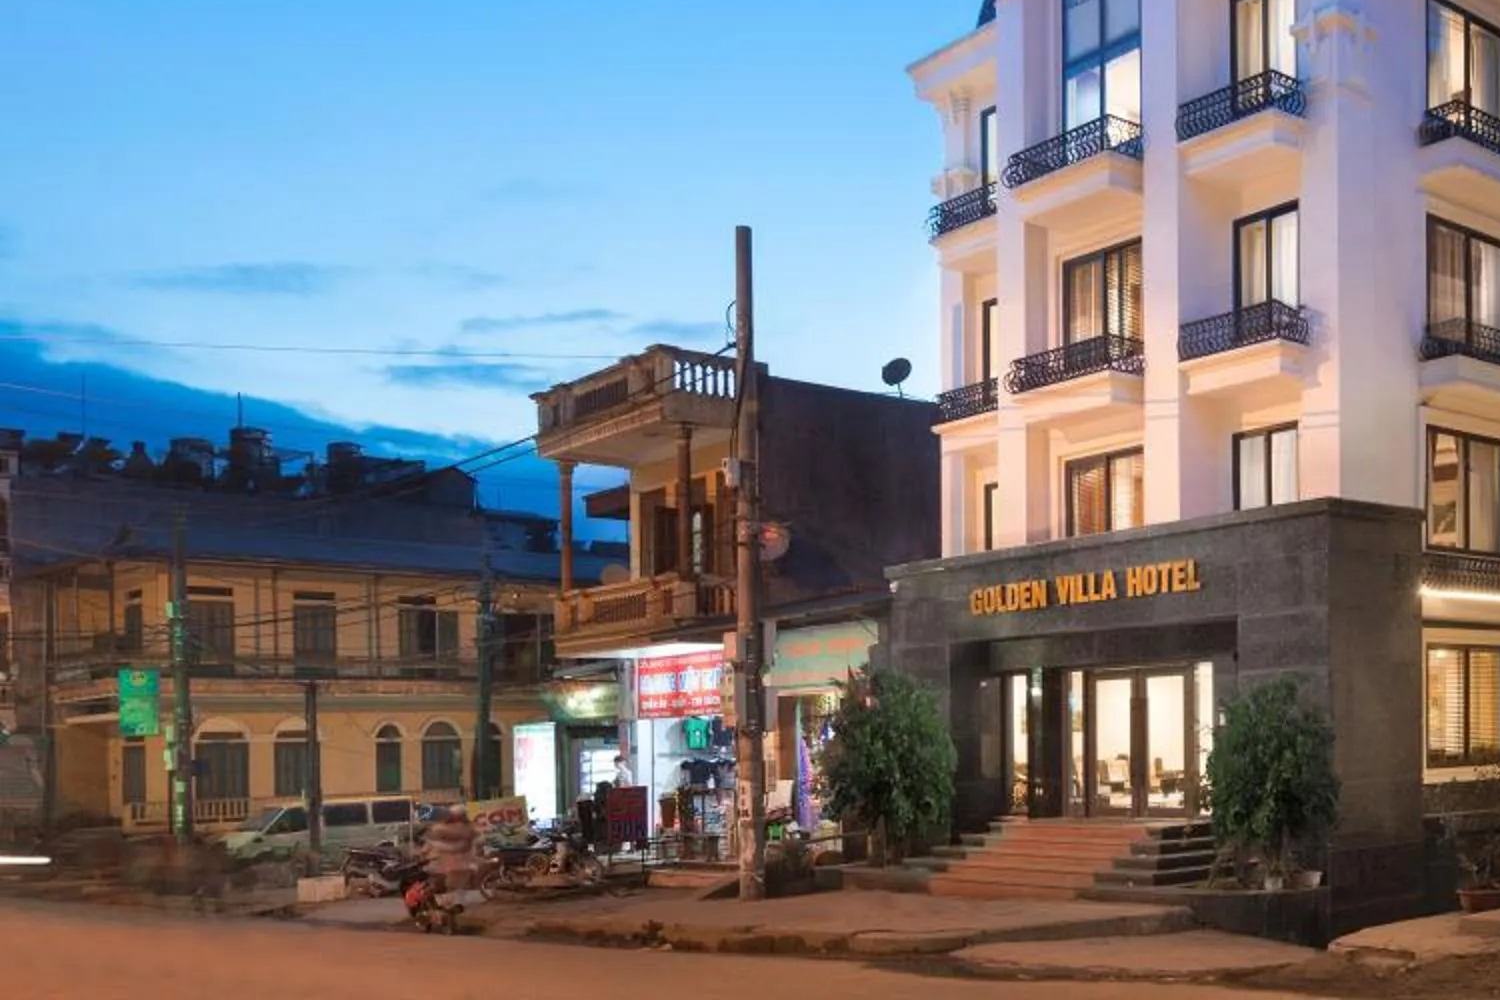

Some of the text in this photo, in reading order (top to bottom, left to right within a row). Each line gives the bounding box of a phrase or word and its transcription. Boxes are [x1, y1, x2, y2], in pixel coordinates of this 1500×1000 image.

[970, 558, 1201, 616] GOLDEN VILLA HOTEL
